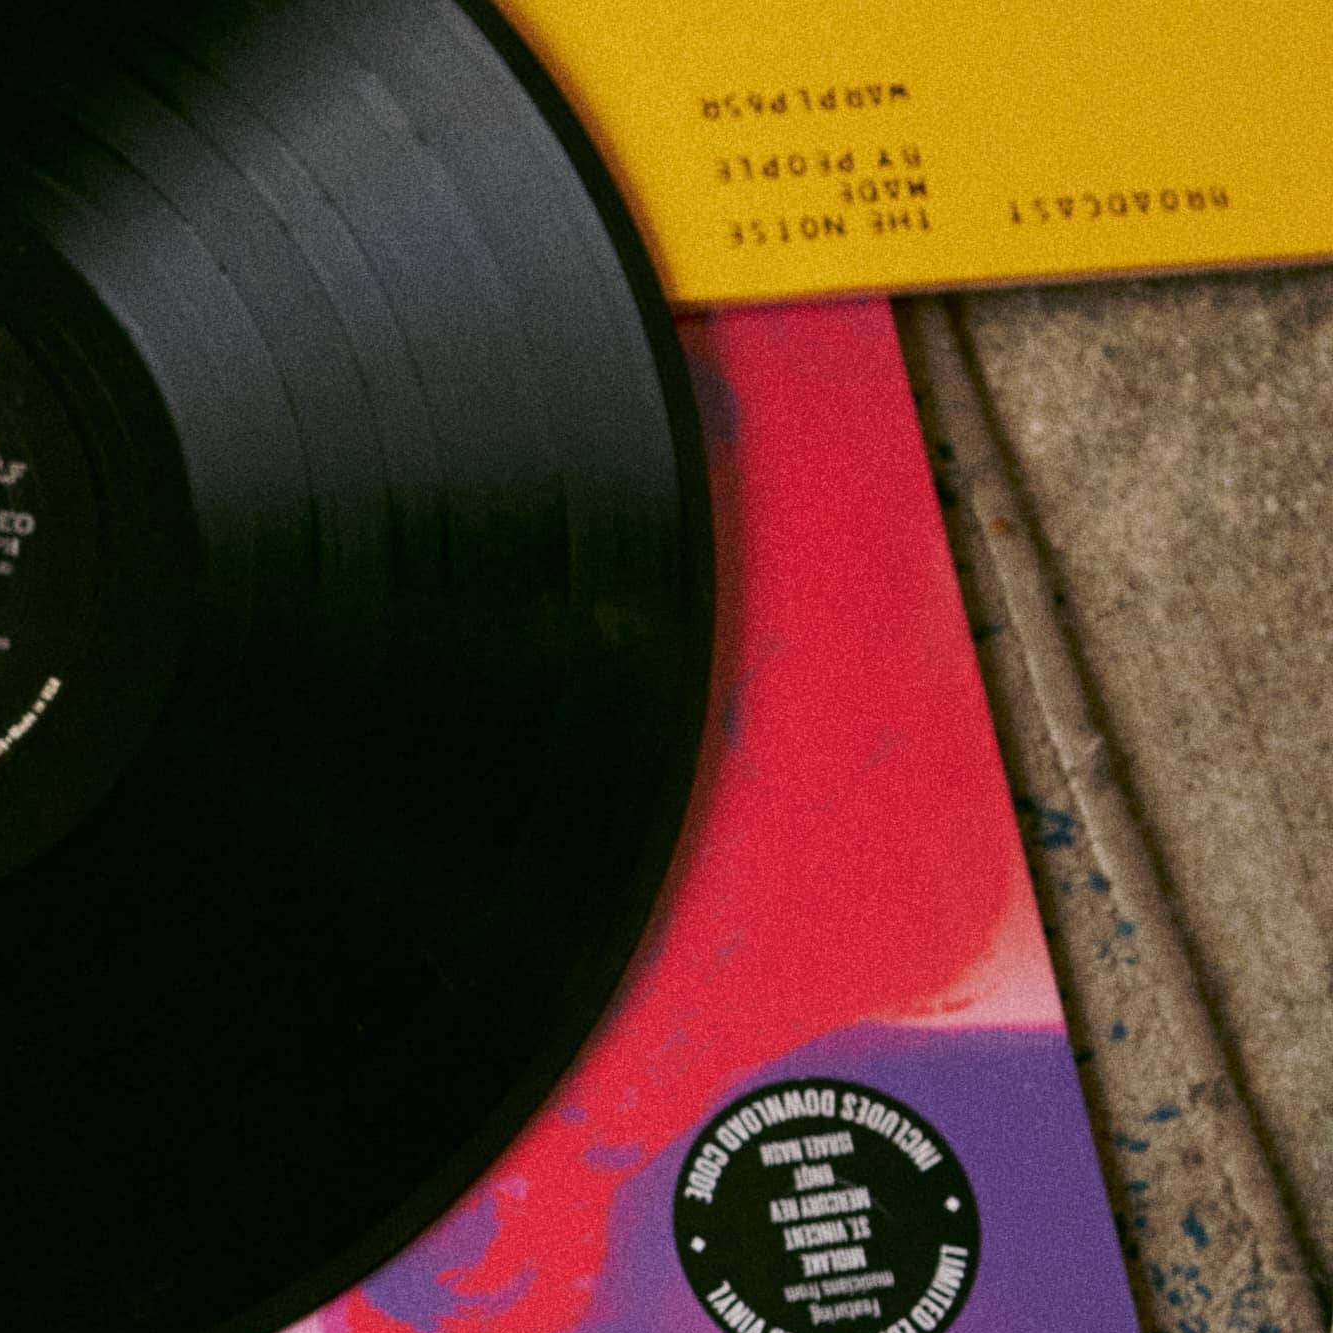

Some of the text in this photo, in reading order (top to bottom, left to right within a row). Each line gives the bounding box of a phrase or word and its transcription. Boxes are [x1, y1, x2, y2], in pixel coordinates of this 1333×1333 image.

[717, 144, 922, 184] BY PEOPLE
[840, 178, 928, 205] MADE
[1009, 185, 1229, 225] BROADCAST
[731, 208, 931, 245] THE NOISE
[684, 1087, 944, 1205] INCLUDES DOWNLOAD CODE
[758, 1130, 855, 1168] ISRAEL NASH
[769, 1186, 872, 1224] MERCURY REV
[783, 1219, 848, 1251] VINCENT
[784, 1270, 896, 1303] musicians from
[909, 1243, 969, 1332] LIMITED
[808, 1297, 881, 1326] Featuring
